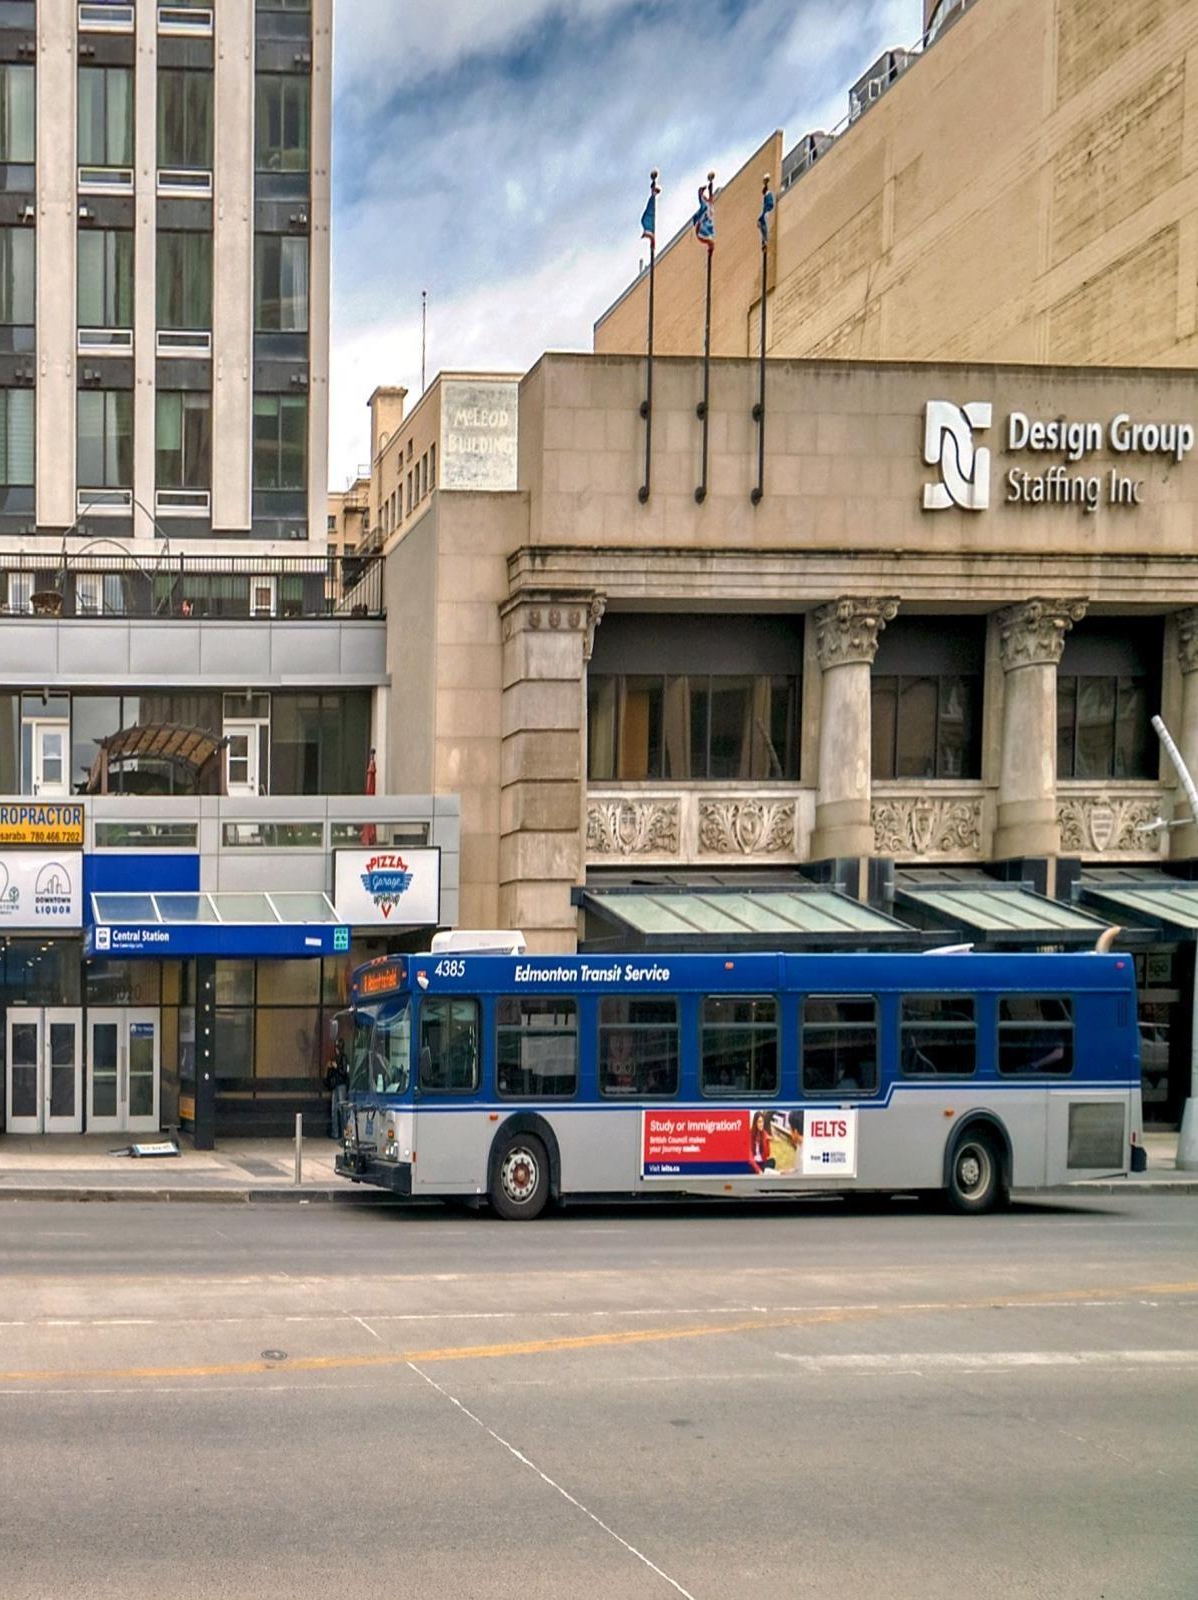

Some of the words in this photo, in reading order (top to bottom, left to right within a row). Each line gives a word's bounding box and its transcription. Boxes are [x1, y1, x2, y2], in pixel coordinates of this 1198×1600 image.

[448, 433, 514, 455] BUILDING
[1009, 412, 1102, 461] Design
[1110, 413, 1194, 461] Group
[1008, 466, 1101, 511] Staffing
[1110, 469, 1143, 503] Inc
[30, 831, 80, 842] 780.466.7202
[370, 856, 403, 869] PIZZA
[372, 875, 403, 891] Garage
[35, 906, 71, 915] LIQUOR
[112, 929, 141, 941] Central
[142, 930, 170, 942] Station
[435, 960, 465, 977] 4385
[514, 964, 578, 982] Edmonton
[581, 964, 622, 982] Transit
[625, 964, 670, 982] Service
[650, 1120, 675, 1134] Study
[676, 1122, 685, 1132] or
[687, 1120, 742, 1134] Immigration?
[811, 1120, 847, 1138] IELTS
[668, 1136, 688, 1144] Council
